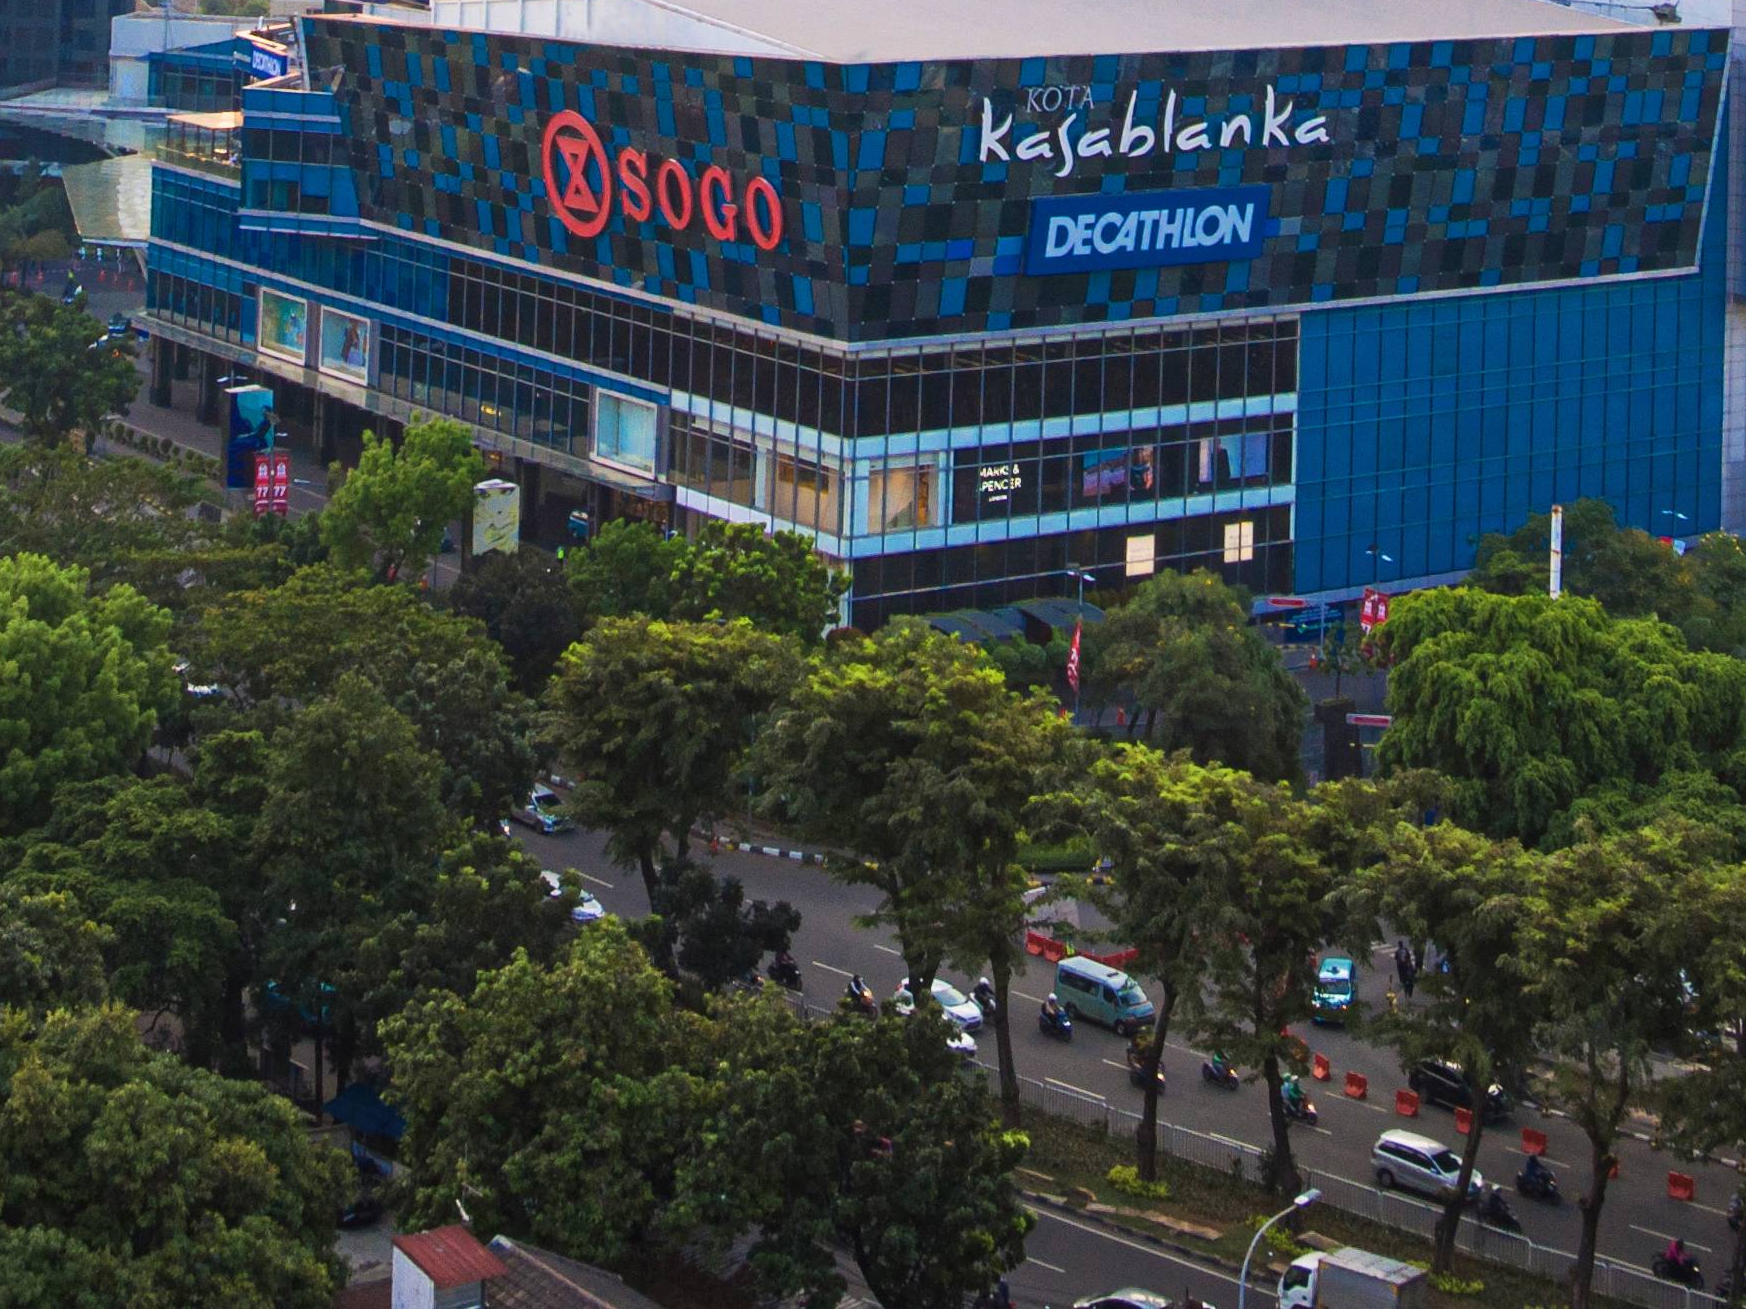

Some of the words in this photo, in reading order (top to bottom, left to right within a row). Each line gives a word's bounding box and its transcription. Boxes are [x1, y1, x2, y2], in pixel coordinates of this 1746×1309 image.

[1025, 85, 1094, 113] KOTA
[617, 147, 784, 251] SOGO
[1044, 203, 1255, 258] DECATHLON
[978, 477, 1022, 492] PENCER
